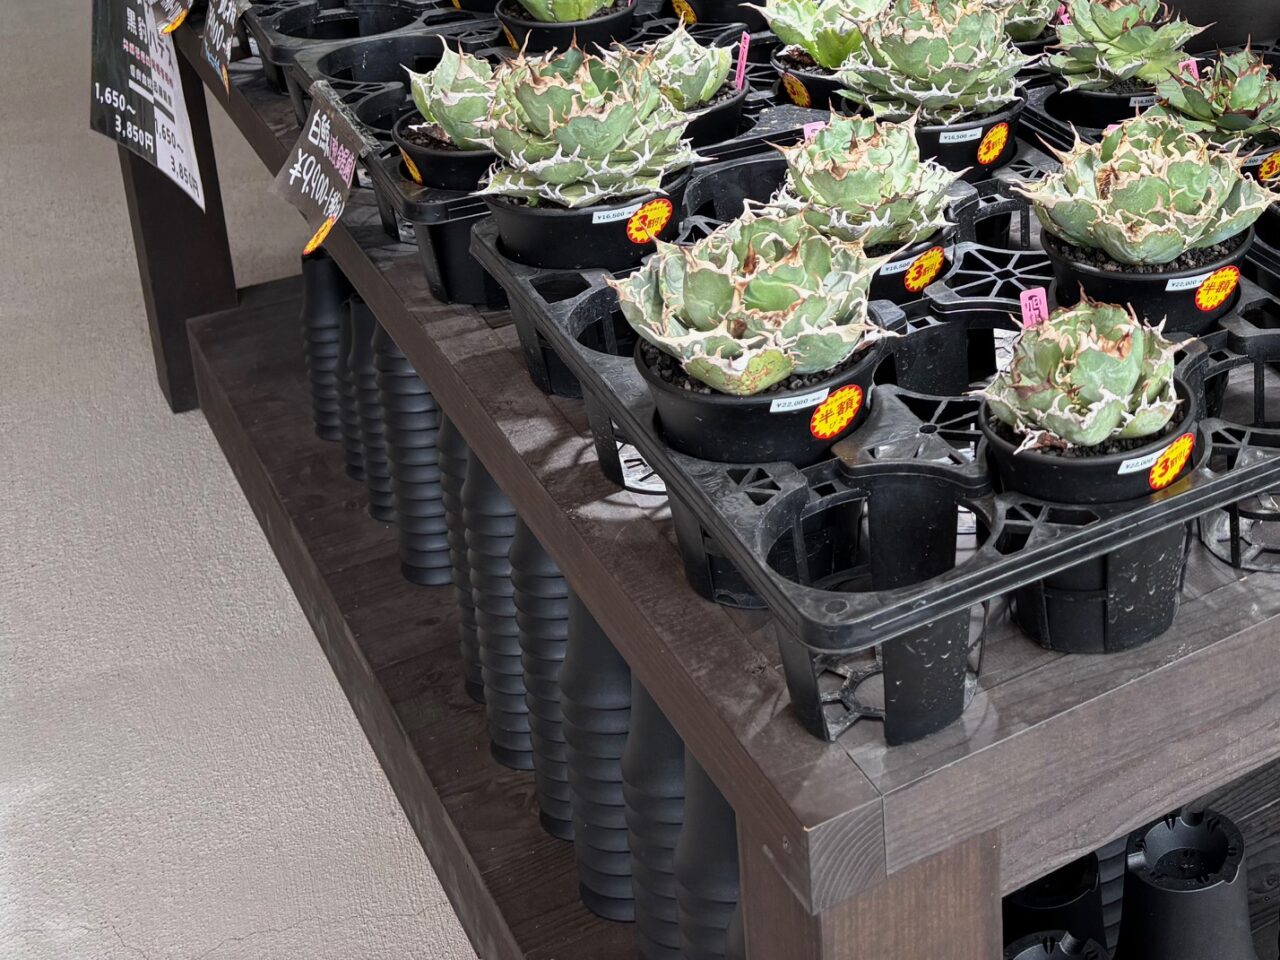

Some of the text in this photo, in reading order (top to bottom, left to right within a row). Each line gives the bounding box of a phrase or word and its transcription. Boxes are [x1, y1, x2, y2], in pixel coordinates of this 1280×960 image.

[115, 114, 154, 154] 3,850円
[776, 398, 809, 410] ¥22,000
[818, 396, 854, 424] 半額
